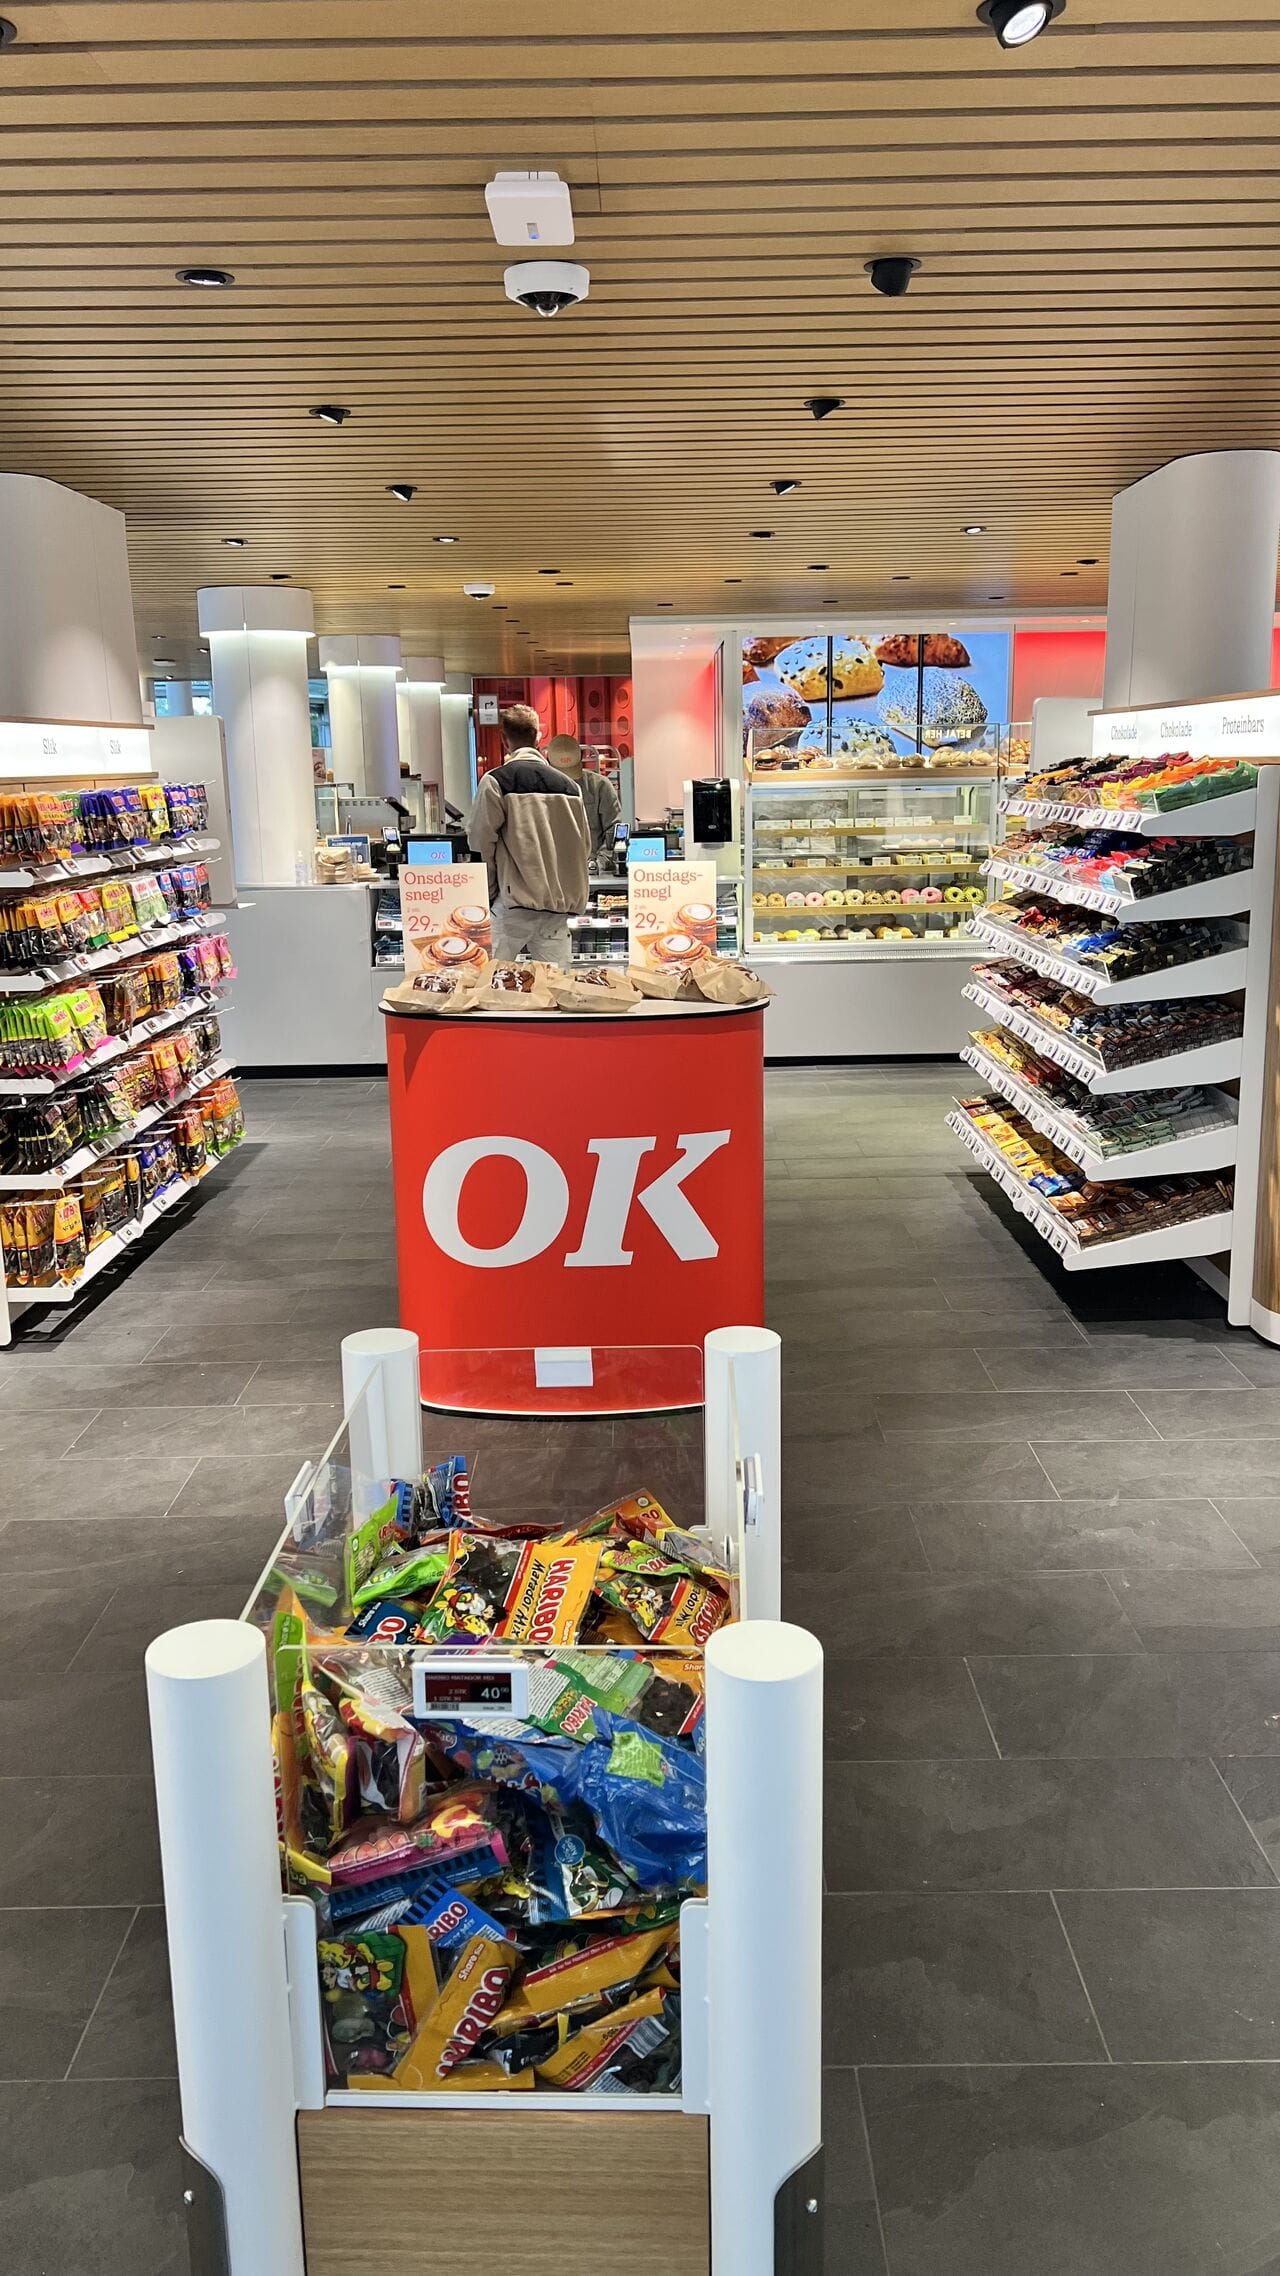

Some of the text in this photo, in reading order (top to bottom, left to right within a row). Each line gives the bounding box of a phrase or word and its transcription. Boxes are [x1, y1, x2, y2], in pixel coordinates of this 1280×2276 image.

[1111, 724, 1138, 740] Chokolade
[1160, 721, 1192, 738] Chokolade
[1222, 715, 1264, 735] Proteinbars
[404, 871, 475, 887] Onsdags-
[633, 869, 704, 885] Onsdags-
[405, 887, 444, 904] snegl
[633, 885, 672, 901] snegl
[408, 915, 439, 933] 29,-
[635, 912, 665, 930] 29,-
[422, 1129, 731, 1268] OK
[511, 1558, 546, 1638] Matador Mix
[527, 1558, 577, 1644] HARIBO
[683, 1663, 705, 1672] Shar
[560, 1694, 598, 1734] HARIBO
[426, 1901, 468, 1941] RIBO
[458, 1954, 478, 1982] Share
